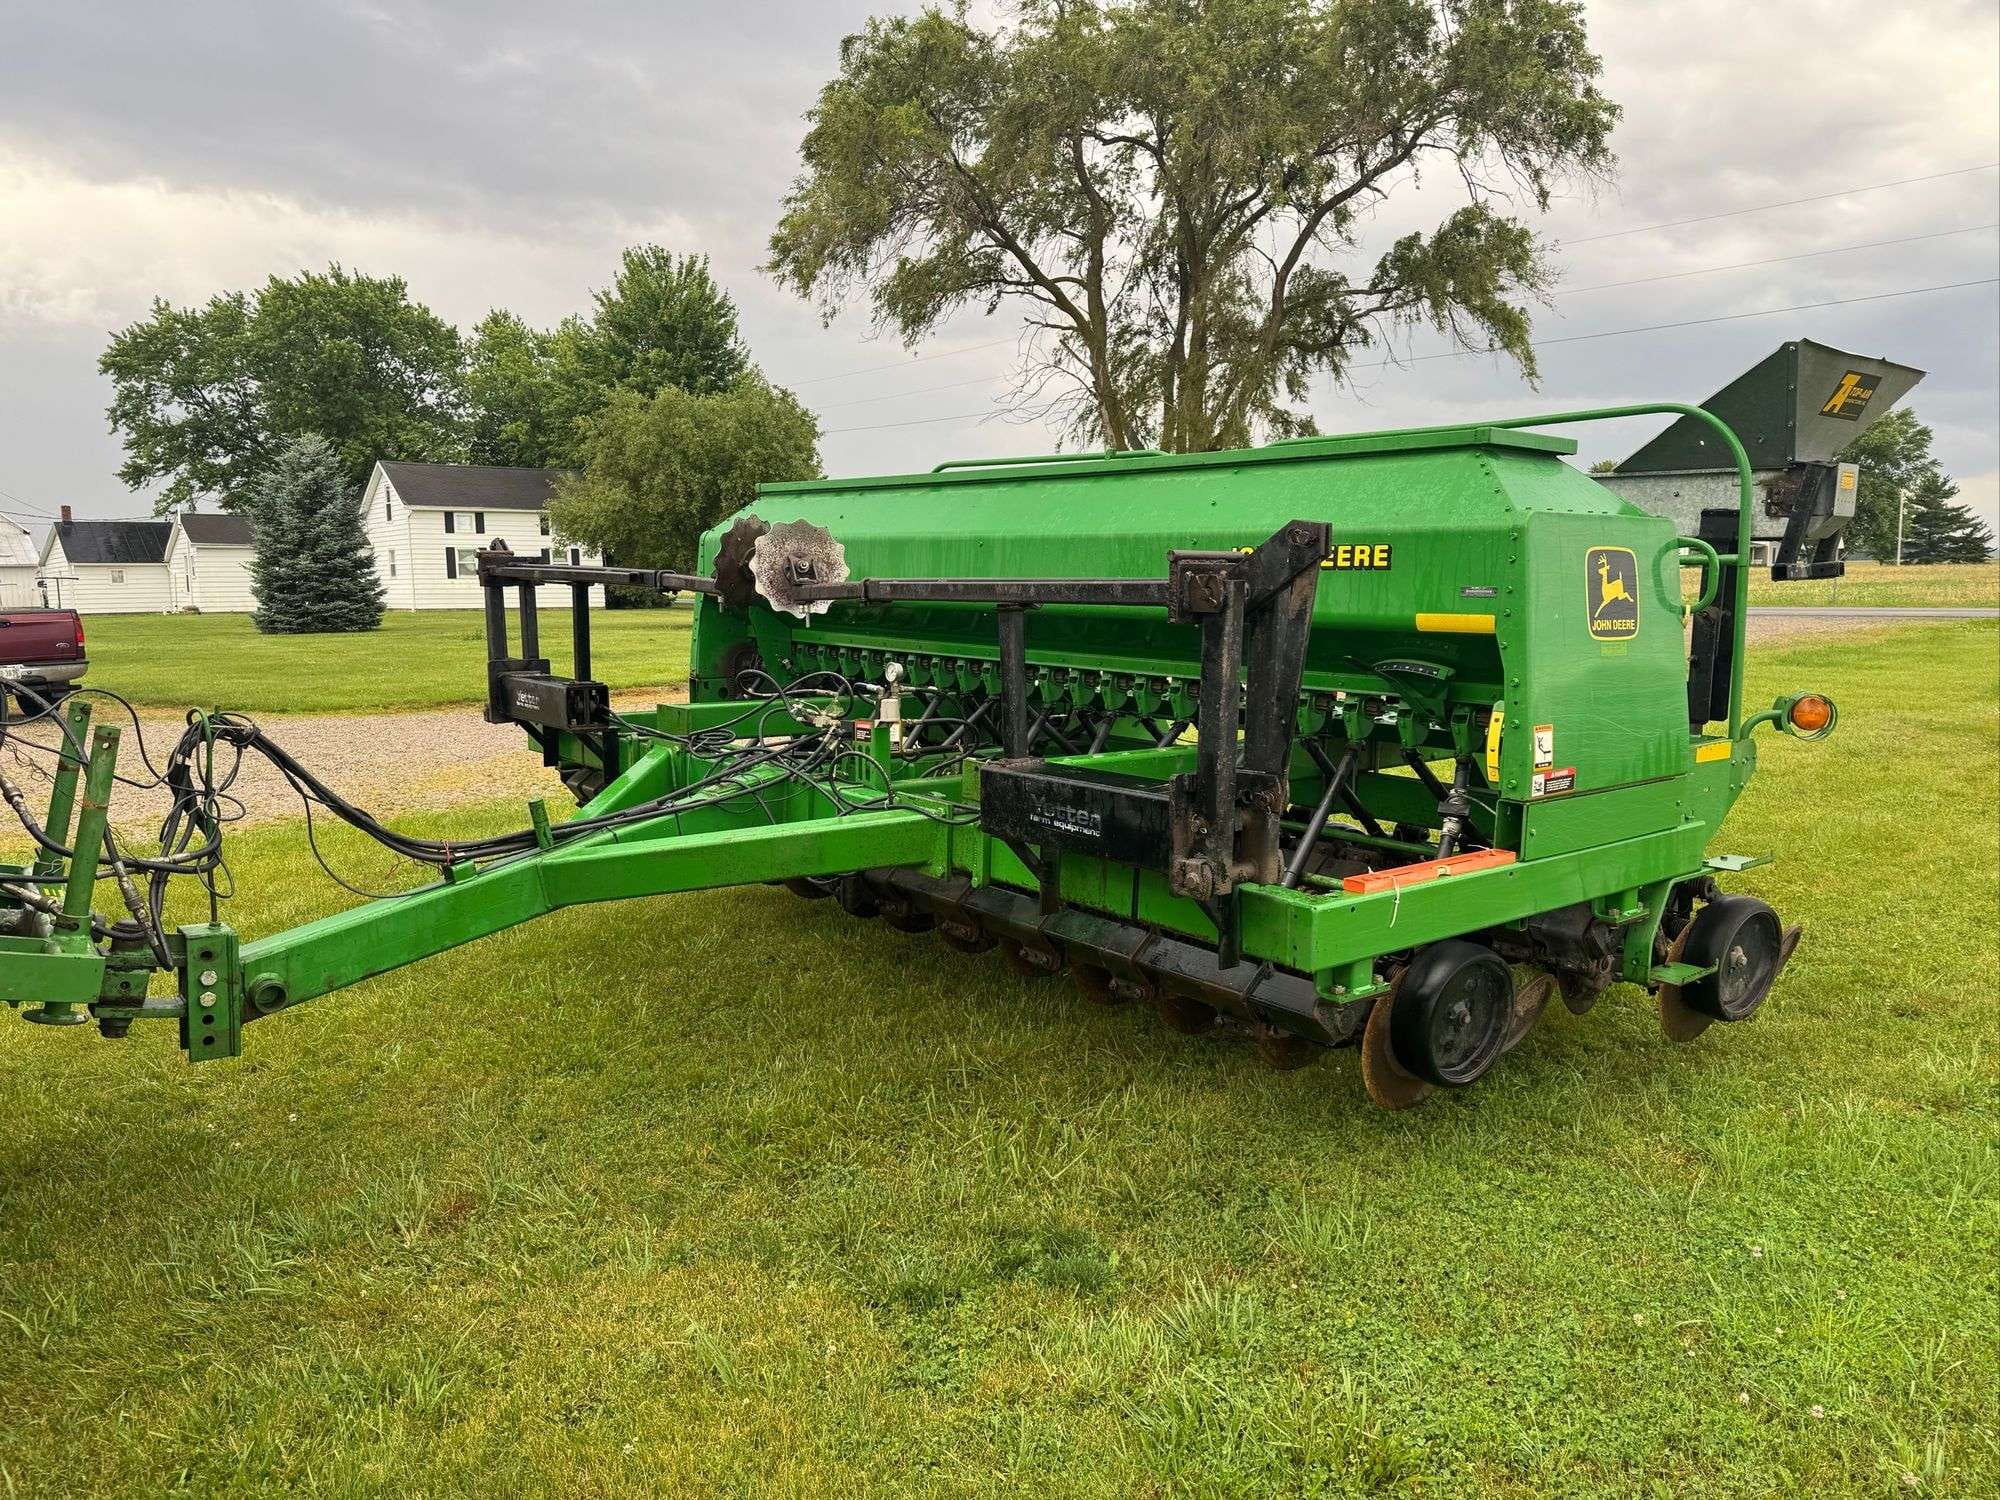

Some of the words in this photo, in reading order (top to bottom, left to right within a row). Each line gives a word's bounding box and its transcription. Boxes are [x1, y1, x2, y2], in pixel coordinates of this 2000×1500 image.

[1320, 544, 1389, 568] ERE
[1592, 619, 1612, 631] JOHN
[1613, 619, 1636, 630] DEERE
